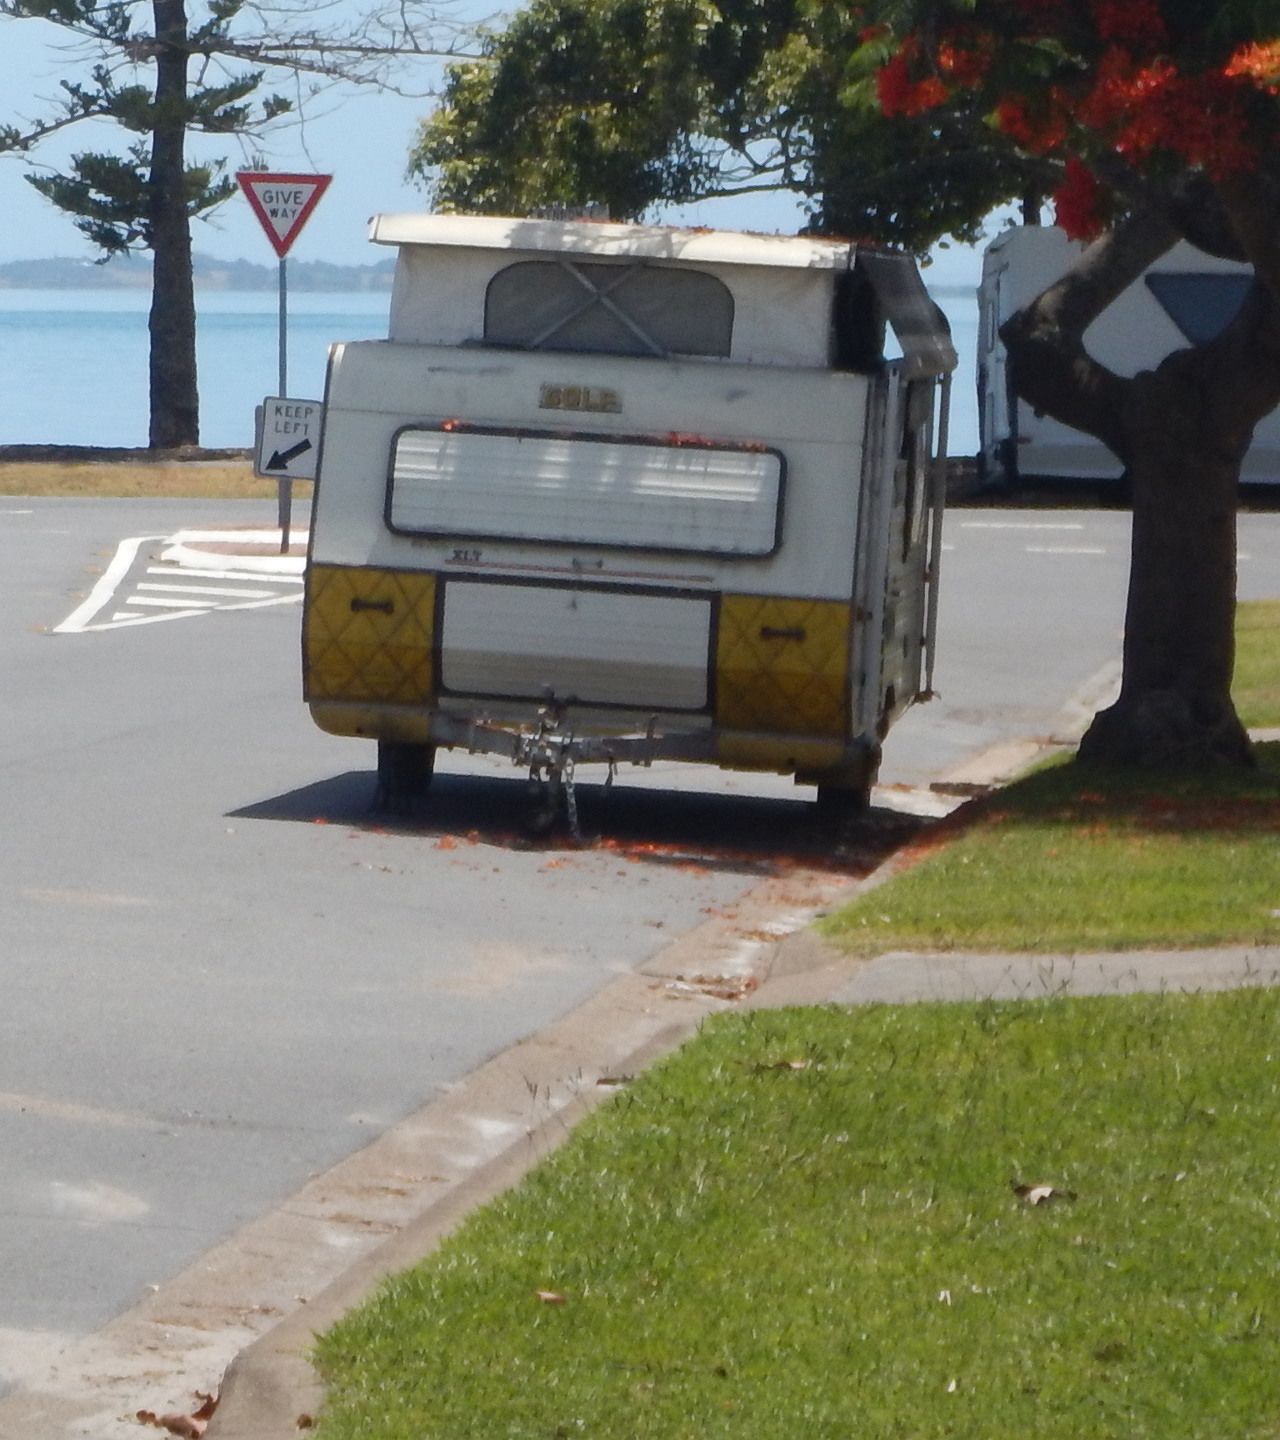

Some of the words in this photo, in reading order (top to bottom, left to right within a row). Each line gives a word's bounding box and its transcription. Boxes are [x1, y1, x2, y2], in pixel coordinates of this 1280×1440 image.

[262, 190, 304, 205] GIVE
[269, 207, 298, 218] WAY
[274, 405, 313, 419] KEEP
[274, 422, 309, 436] LEFT
